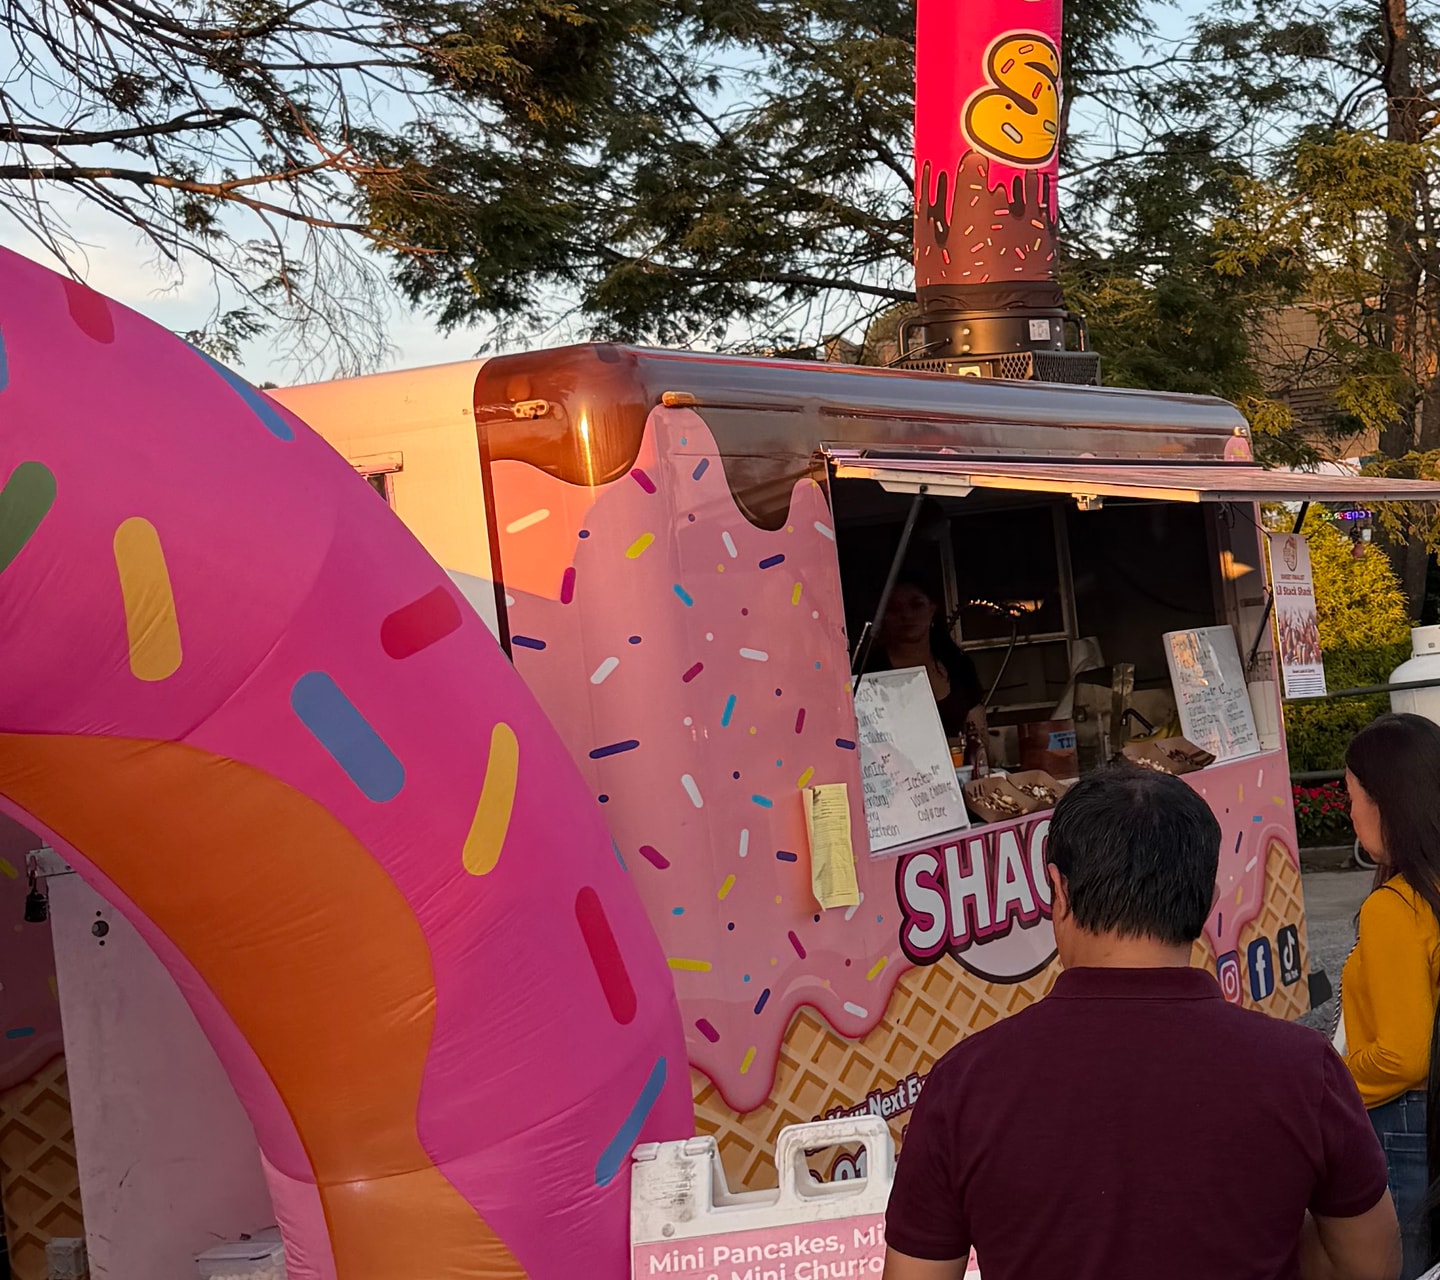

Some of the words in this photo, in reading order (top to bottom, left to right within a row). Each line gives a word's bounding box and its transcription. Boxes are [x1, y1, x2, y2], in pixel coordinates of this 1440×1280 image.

[904, 819, 1053, 951] SHAC
[869, 1084, 907, 1117] Next
[650, 1247, 704, 1274] Mini
[714, 1235, 845, 1267] Pancakes,
[853, 1223, 885, 1248] Mi
[794, 1256, 884, 1280] Churro
